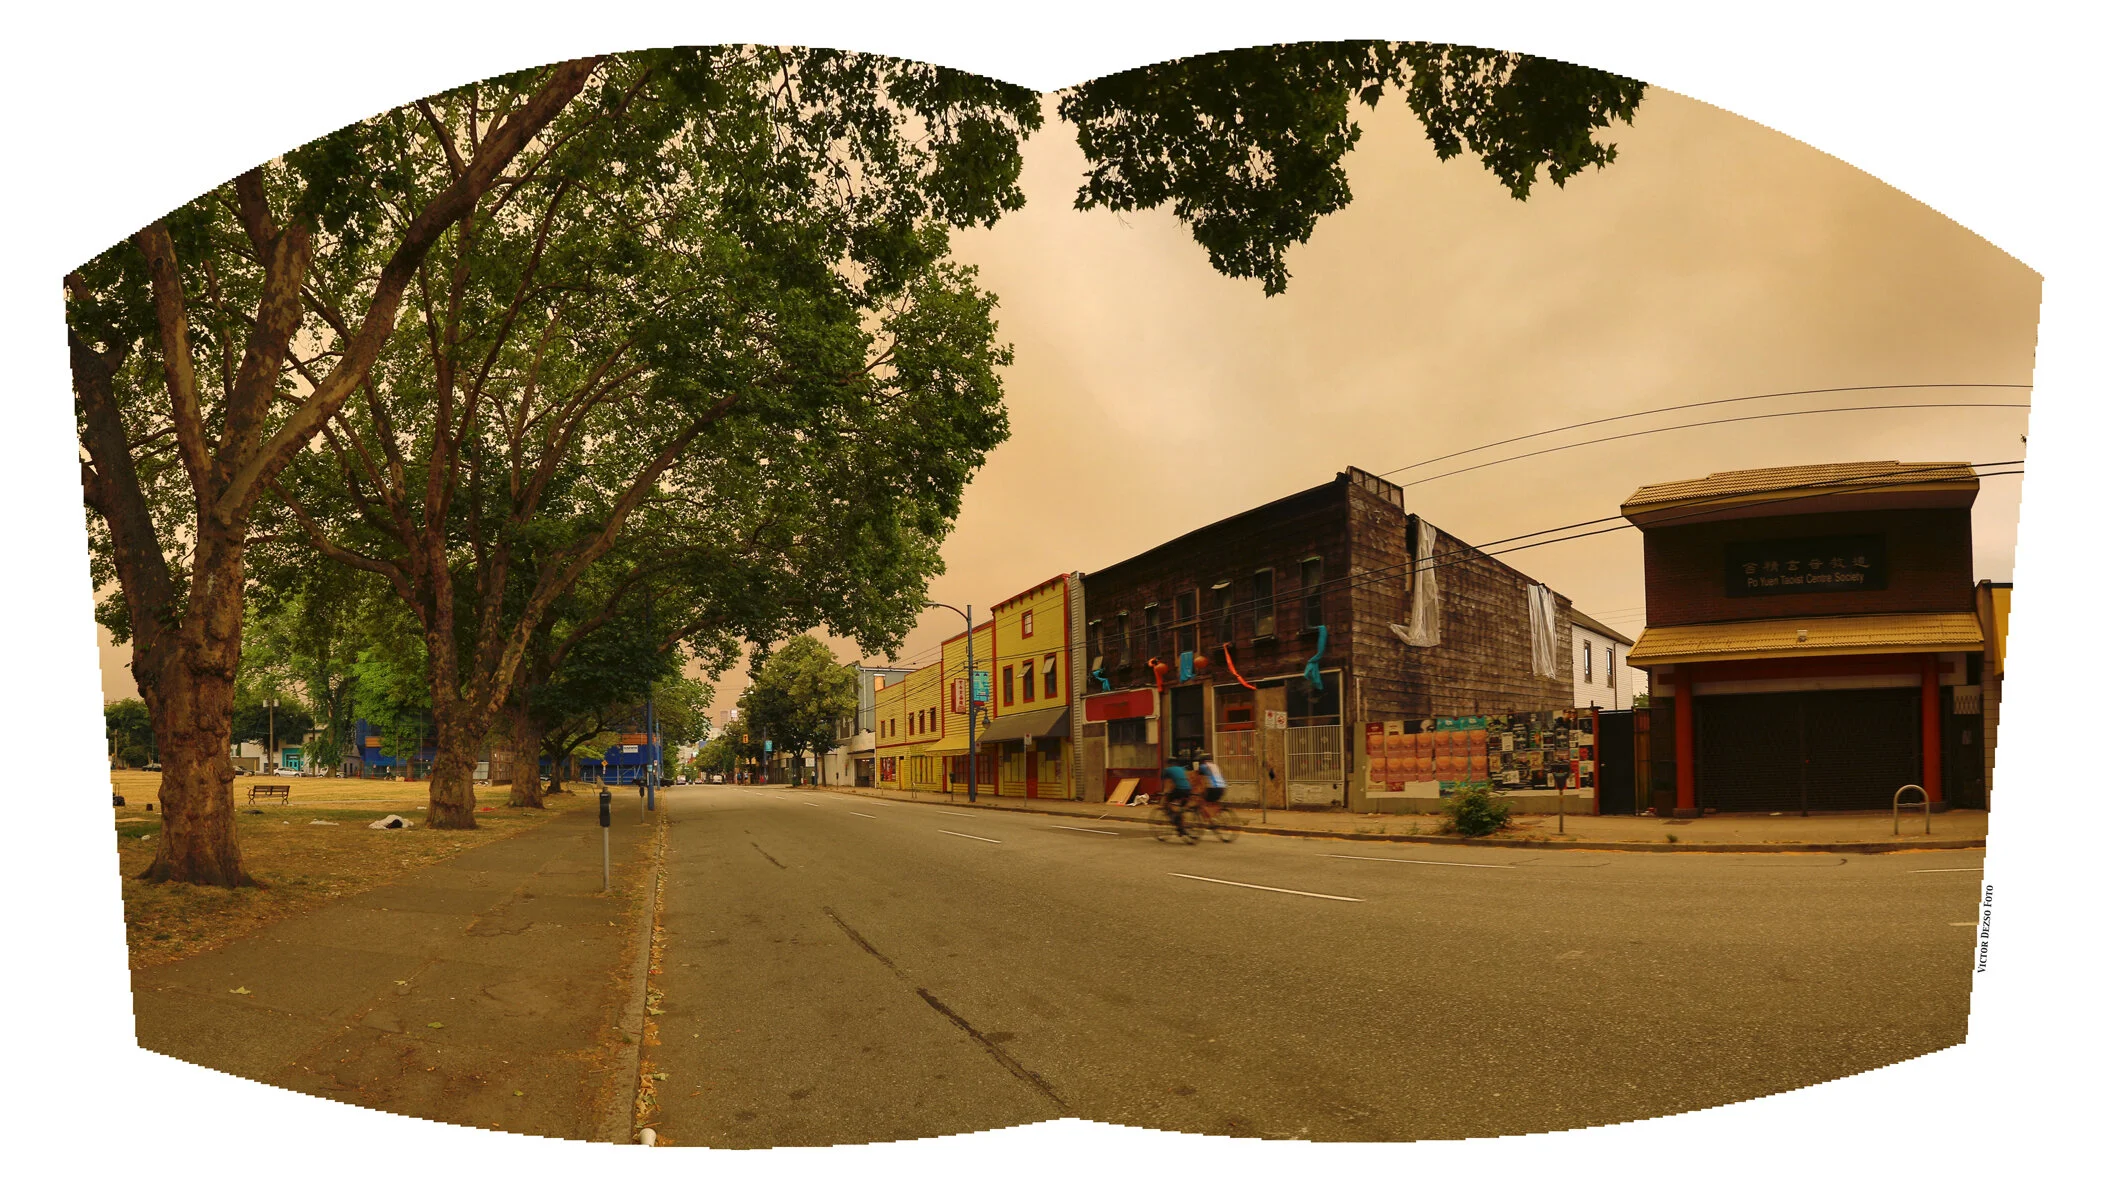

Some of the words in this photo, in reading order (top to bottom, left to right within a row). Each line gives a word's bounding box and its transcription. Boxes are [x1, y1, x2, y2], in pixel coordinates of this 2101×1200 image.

[1747, 577, 1758, 588] Po
[1760, 576, 1779, 586] Yuen
[1780, 575, 1804, 585] Taoist
[1806, 573, 1833, 583] Centre
[1834, 571, 1865, 583] Society
